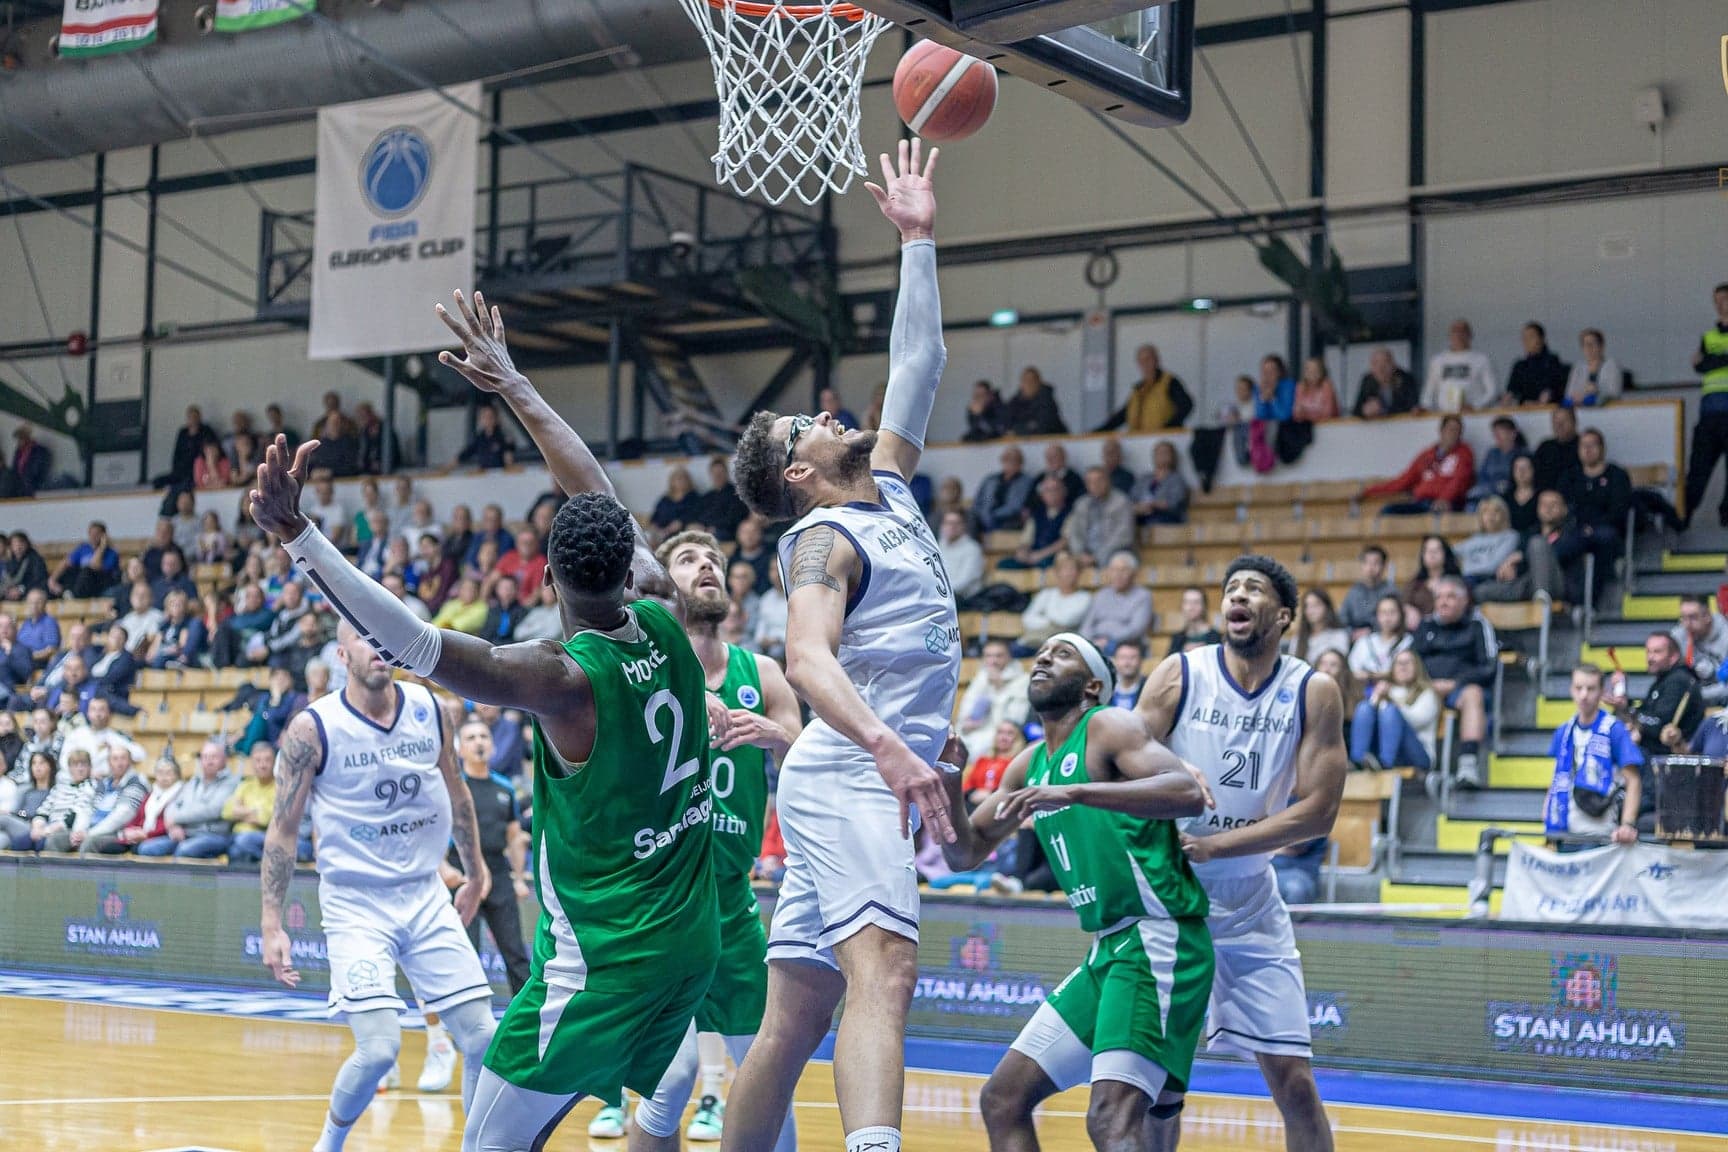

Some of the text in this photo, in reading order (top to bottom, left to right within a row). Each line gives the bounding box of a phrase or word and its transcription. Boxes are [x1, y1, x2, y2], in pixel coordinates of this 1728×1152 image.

[329, 238, 465, 270] EUROPE CUP
[1191, 706, 1229, 729] ALBA
[343, 736, 435, 769] ALBA FEHÉRVÁR
[644, 689, 700, 796] 2
[1219, 749, 1260, 790] 21
[374, 773, 421, 809] 99
[67, 924, 160, 949] STAN AHUJA
[967, 982, 1046, 1004] AHUJA
[1494, 1013, 1676, 1049] STAN AHUJA
